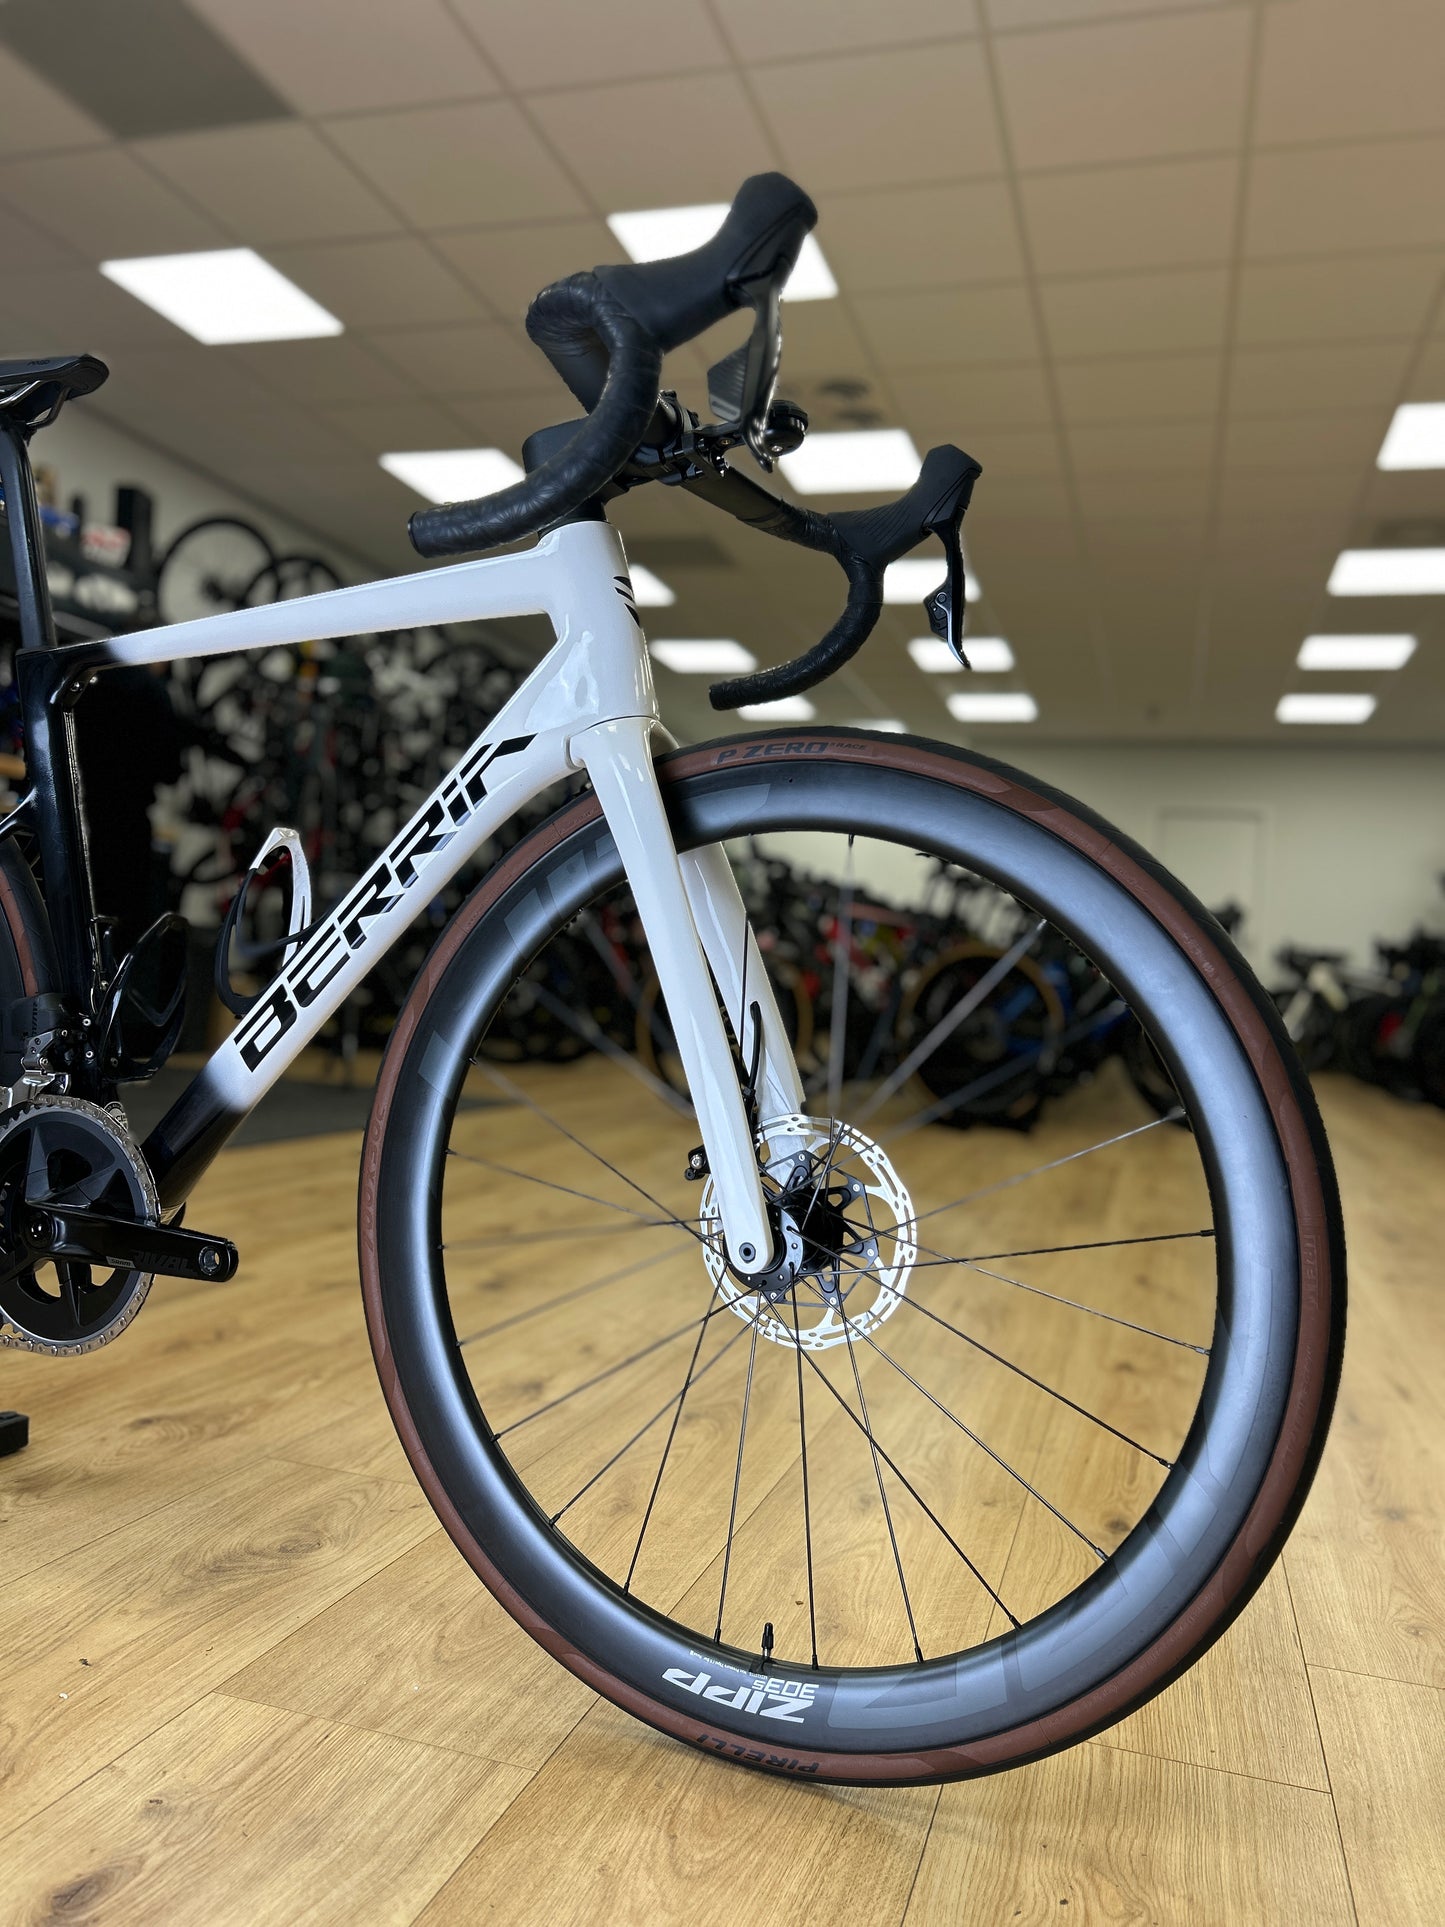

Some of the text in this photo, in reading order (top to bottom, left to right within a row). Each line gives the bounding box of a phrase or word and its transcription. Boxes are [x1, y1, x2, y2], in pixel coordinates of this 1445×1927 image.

[716, 750, 737, 765] P
[742, 742, 829, 759] ZERO
[661, 1668, 814, 1724] ZIPP
[696, 1734, 820, 1774] PIRELLI
